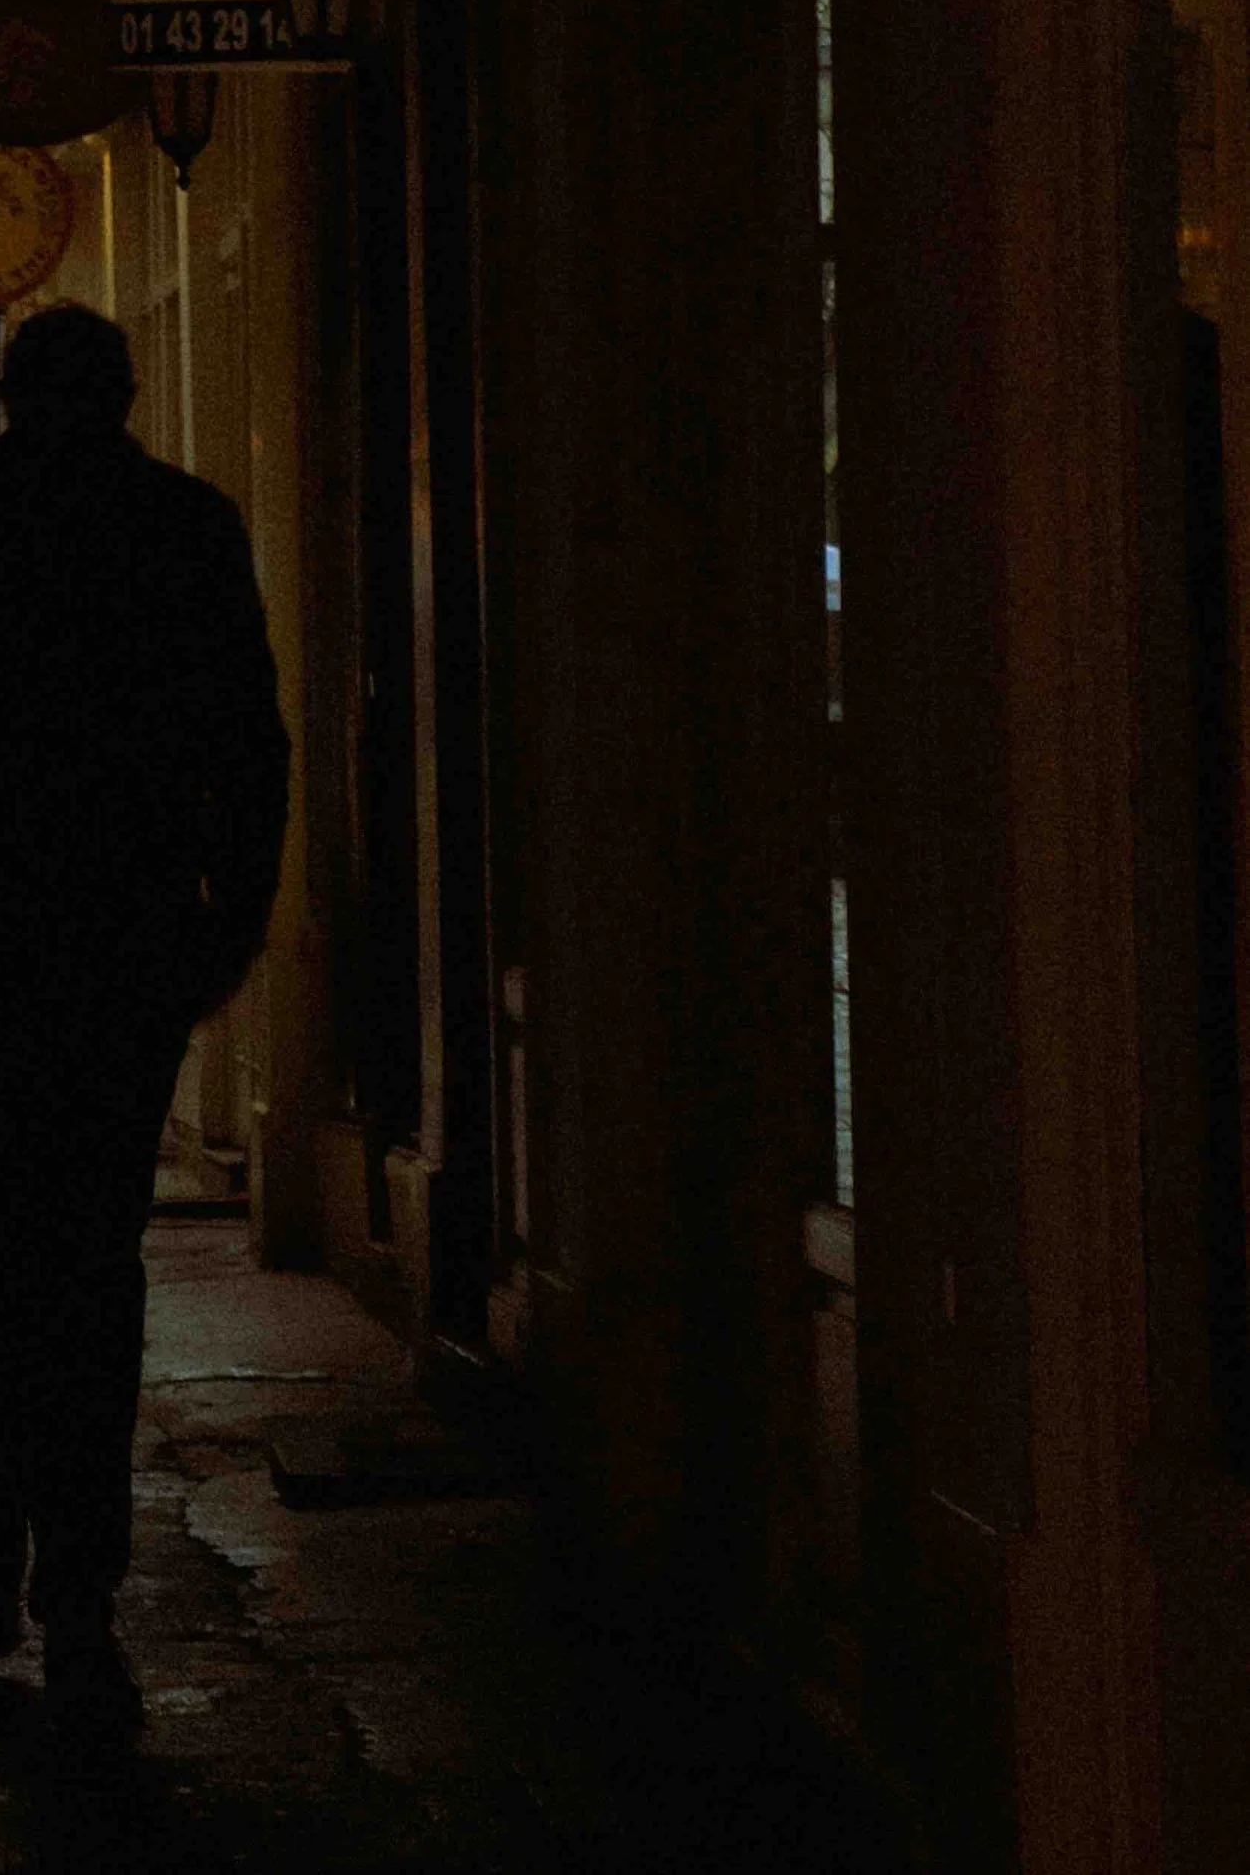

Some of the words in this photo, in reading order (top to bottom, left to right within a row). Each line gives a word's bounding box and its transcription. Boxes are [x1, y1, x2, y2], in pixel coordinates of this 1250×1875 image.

[120, 11, 155, 55] 01
[165, 8, 204, 54] 43
[211, 7, 251, 53] 29
